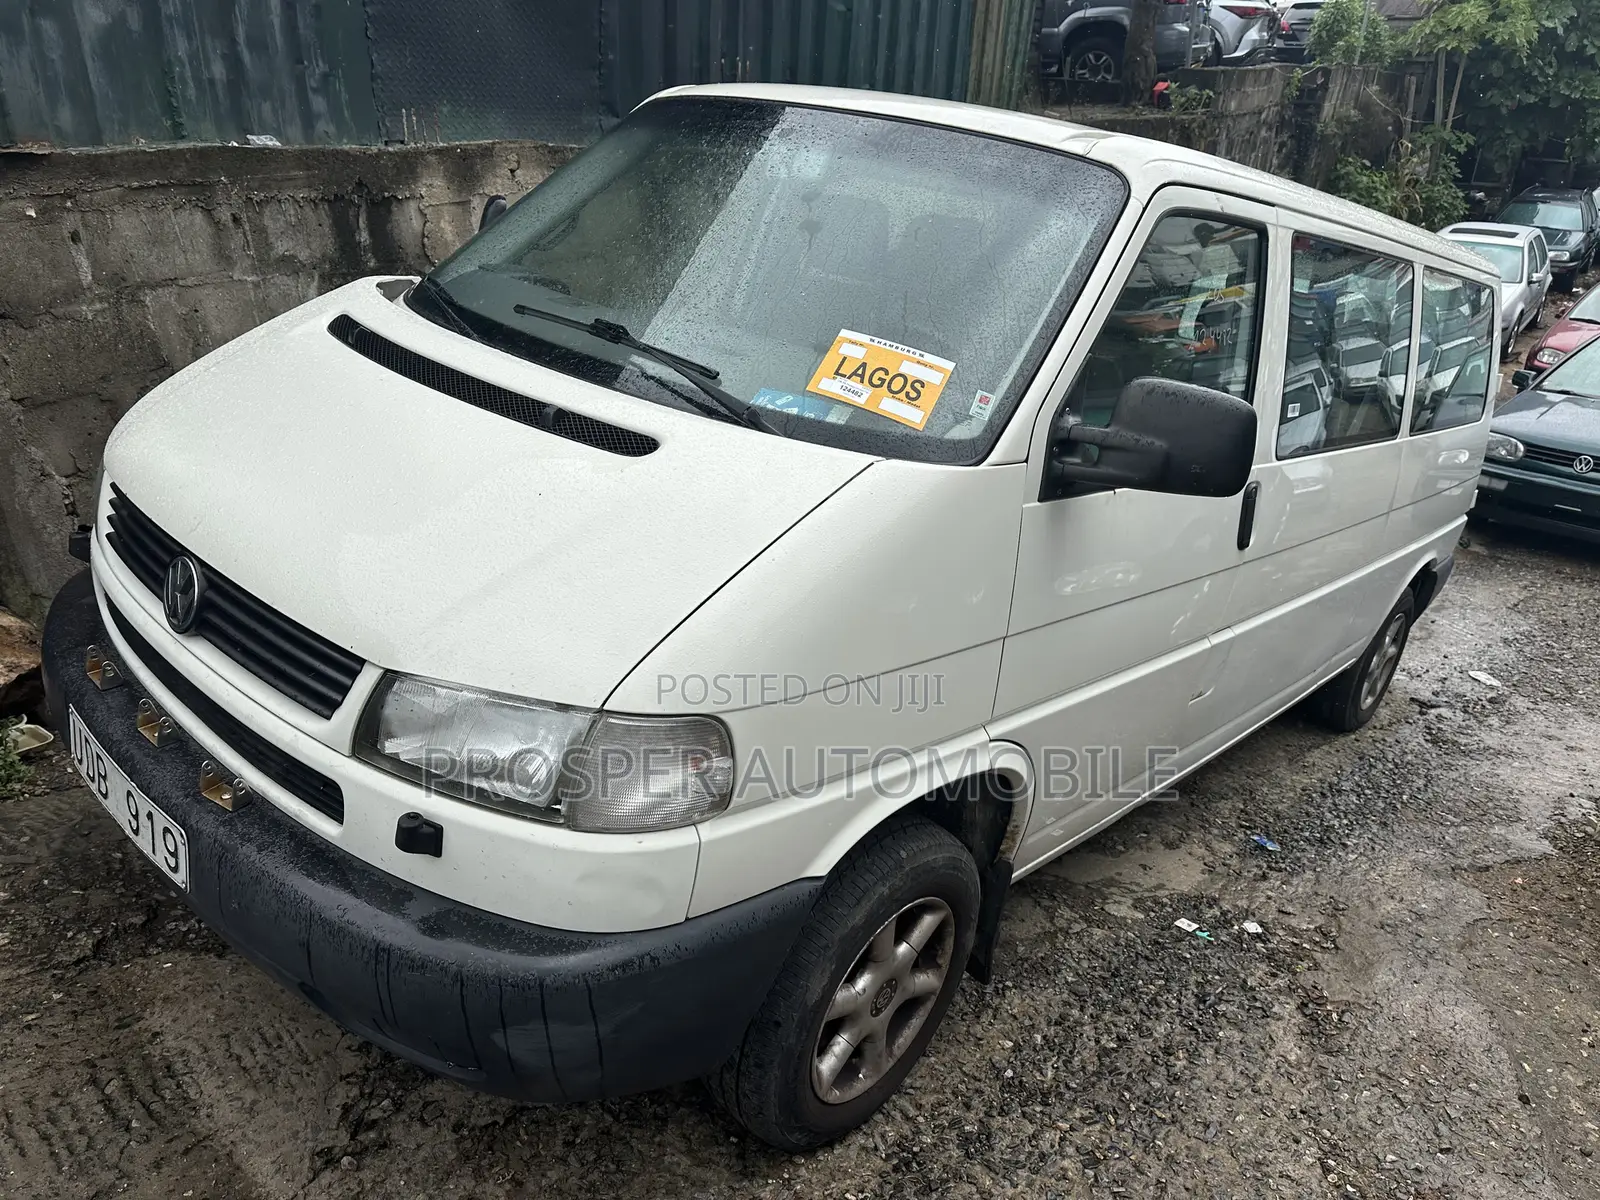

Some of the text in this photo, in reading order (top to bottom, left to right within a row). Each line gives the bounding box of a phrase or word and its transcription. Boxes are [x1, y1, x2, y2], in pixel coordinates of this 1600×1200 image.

[876, 340, 917, 356] HAMBURG
[833, 356, 926, 402] LAGOS
[72, 718, 179, 874] UDB 919
